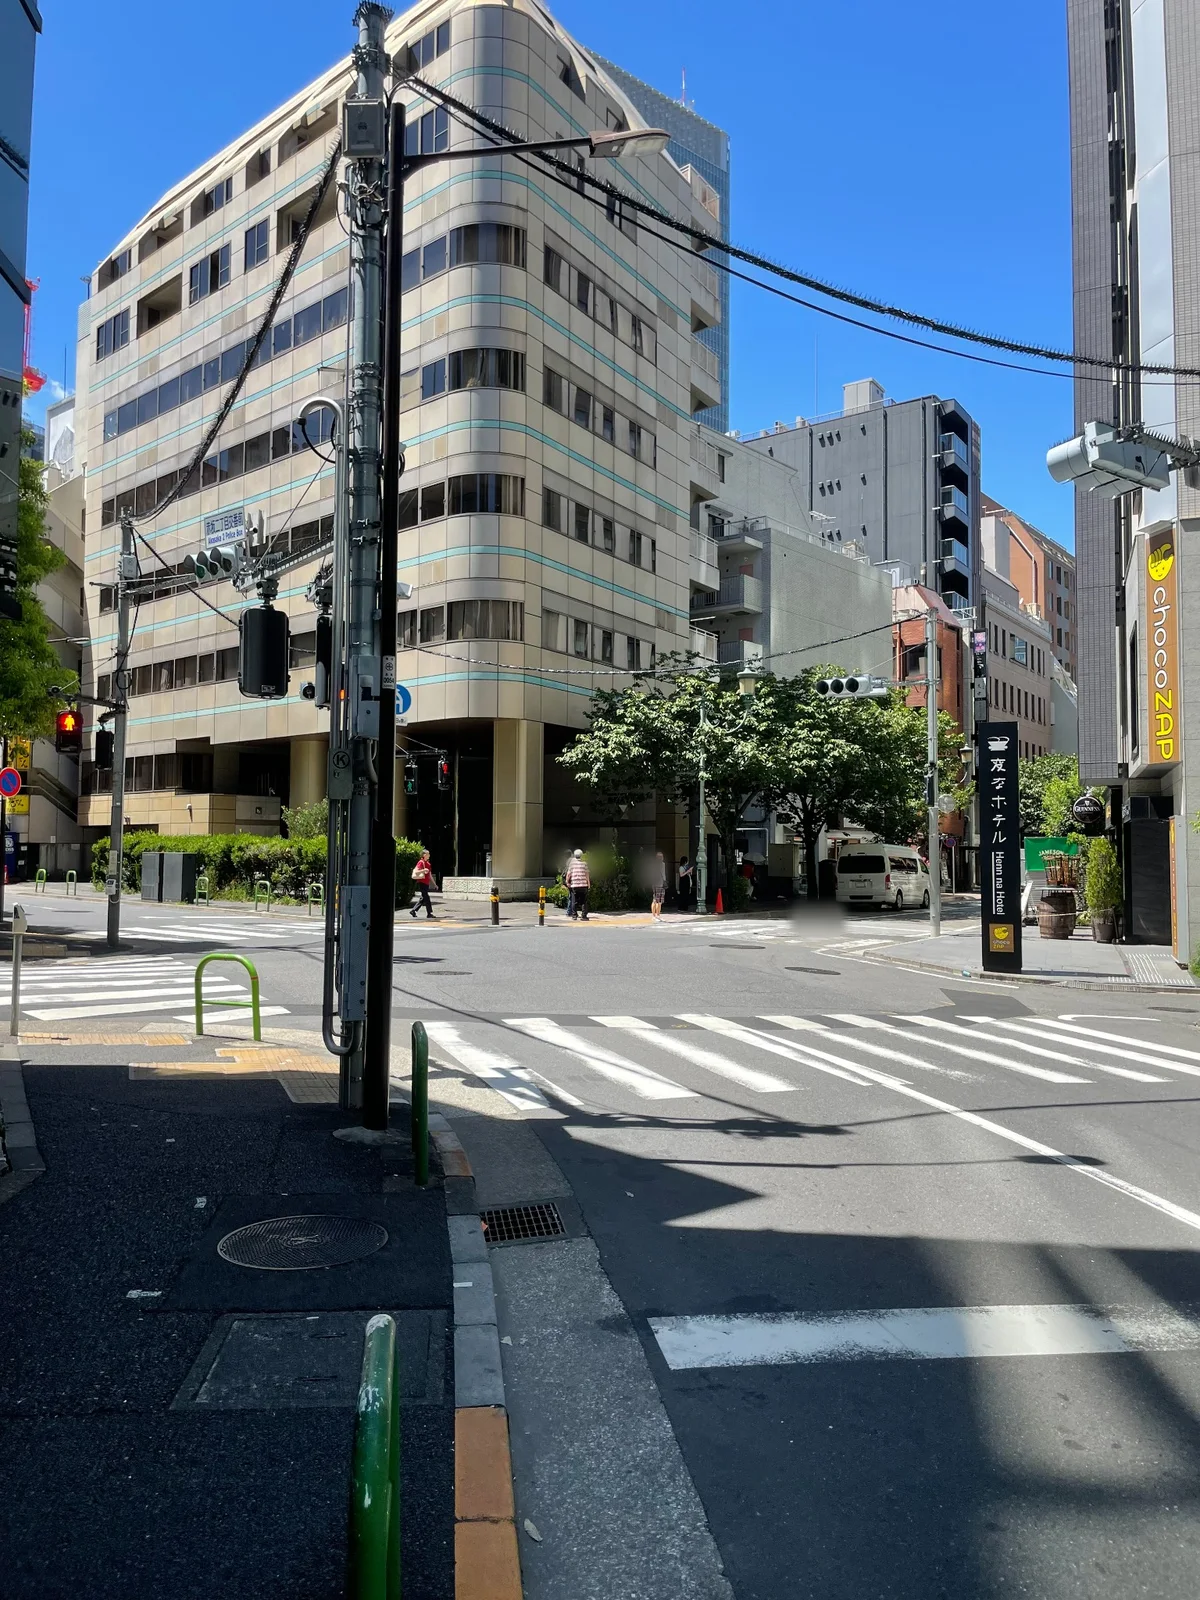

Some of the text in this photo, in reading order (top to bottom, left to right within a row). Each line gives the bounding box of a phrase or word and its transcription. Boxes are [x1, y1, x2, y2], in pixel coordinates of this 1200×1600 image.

[991, 758, 1007, 844] 変なホテル
[995, 851, 1006, 915] Henn na Hotel
